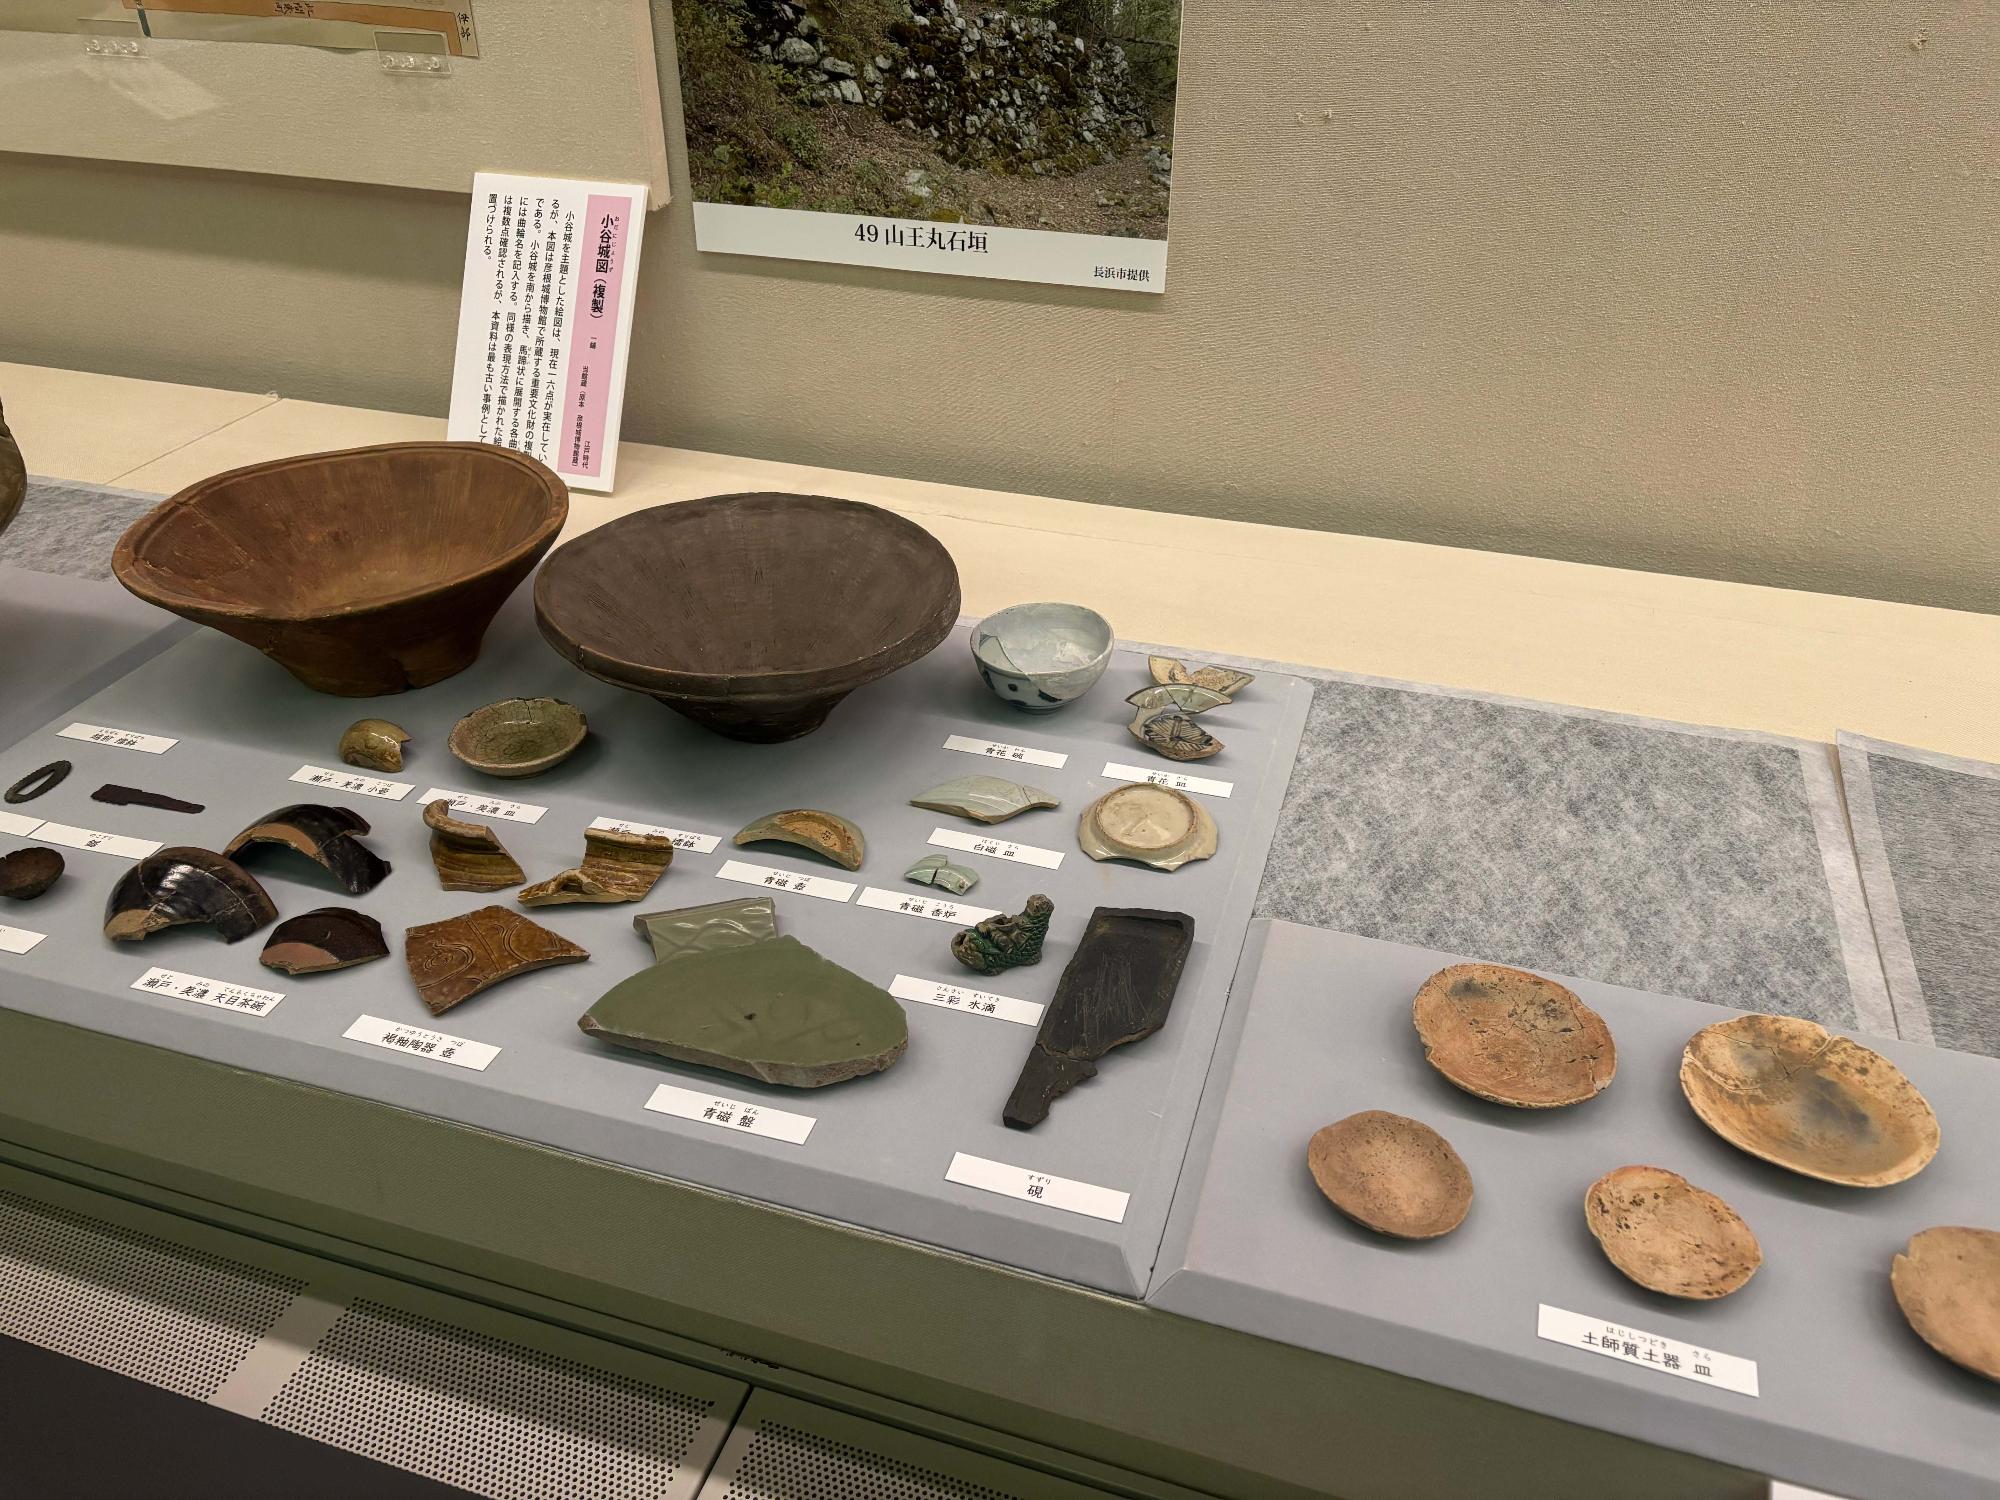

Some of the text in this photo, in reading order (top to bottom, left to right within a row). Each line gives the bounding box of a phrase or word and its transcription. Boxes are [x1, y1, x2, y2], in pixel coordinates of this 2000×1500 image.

[483, 193, 498, 260] 置づけられる。
[854, 223, 989, 254] 49 山王丸石垣
[590, 213, 614, 319] 小谷城図（複製）
[1093, 265, 1151, 282] 長浜市提供
[581, 440, 591, 470] 江戸時代
[973, 843, 997, 855] 白磁
[763, 876, 789, 888] 青磁
[899, 901, 957, 919] 青磁 香炉
[142, 976, 267, 1012] 瀬戸・美濃 天目茶碗
[932, 992, 997, 1014] 三彩 水滴
[380, 1031, 437, 1054] 褐釉陶器
[702, 1106, 756, 1128] 青磁 盤
[1027, 1184, 1044, 1199] 硯
[1581, 1331, 1713, 1378] 土師質土器 皿
